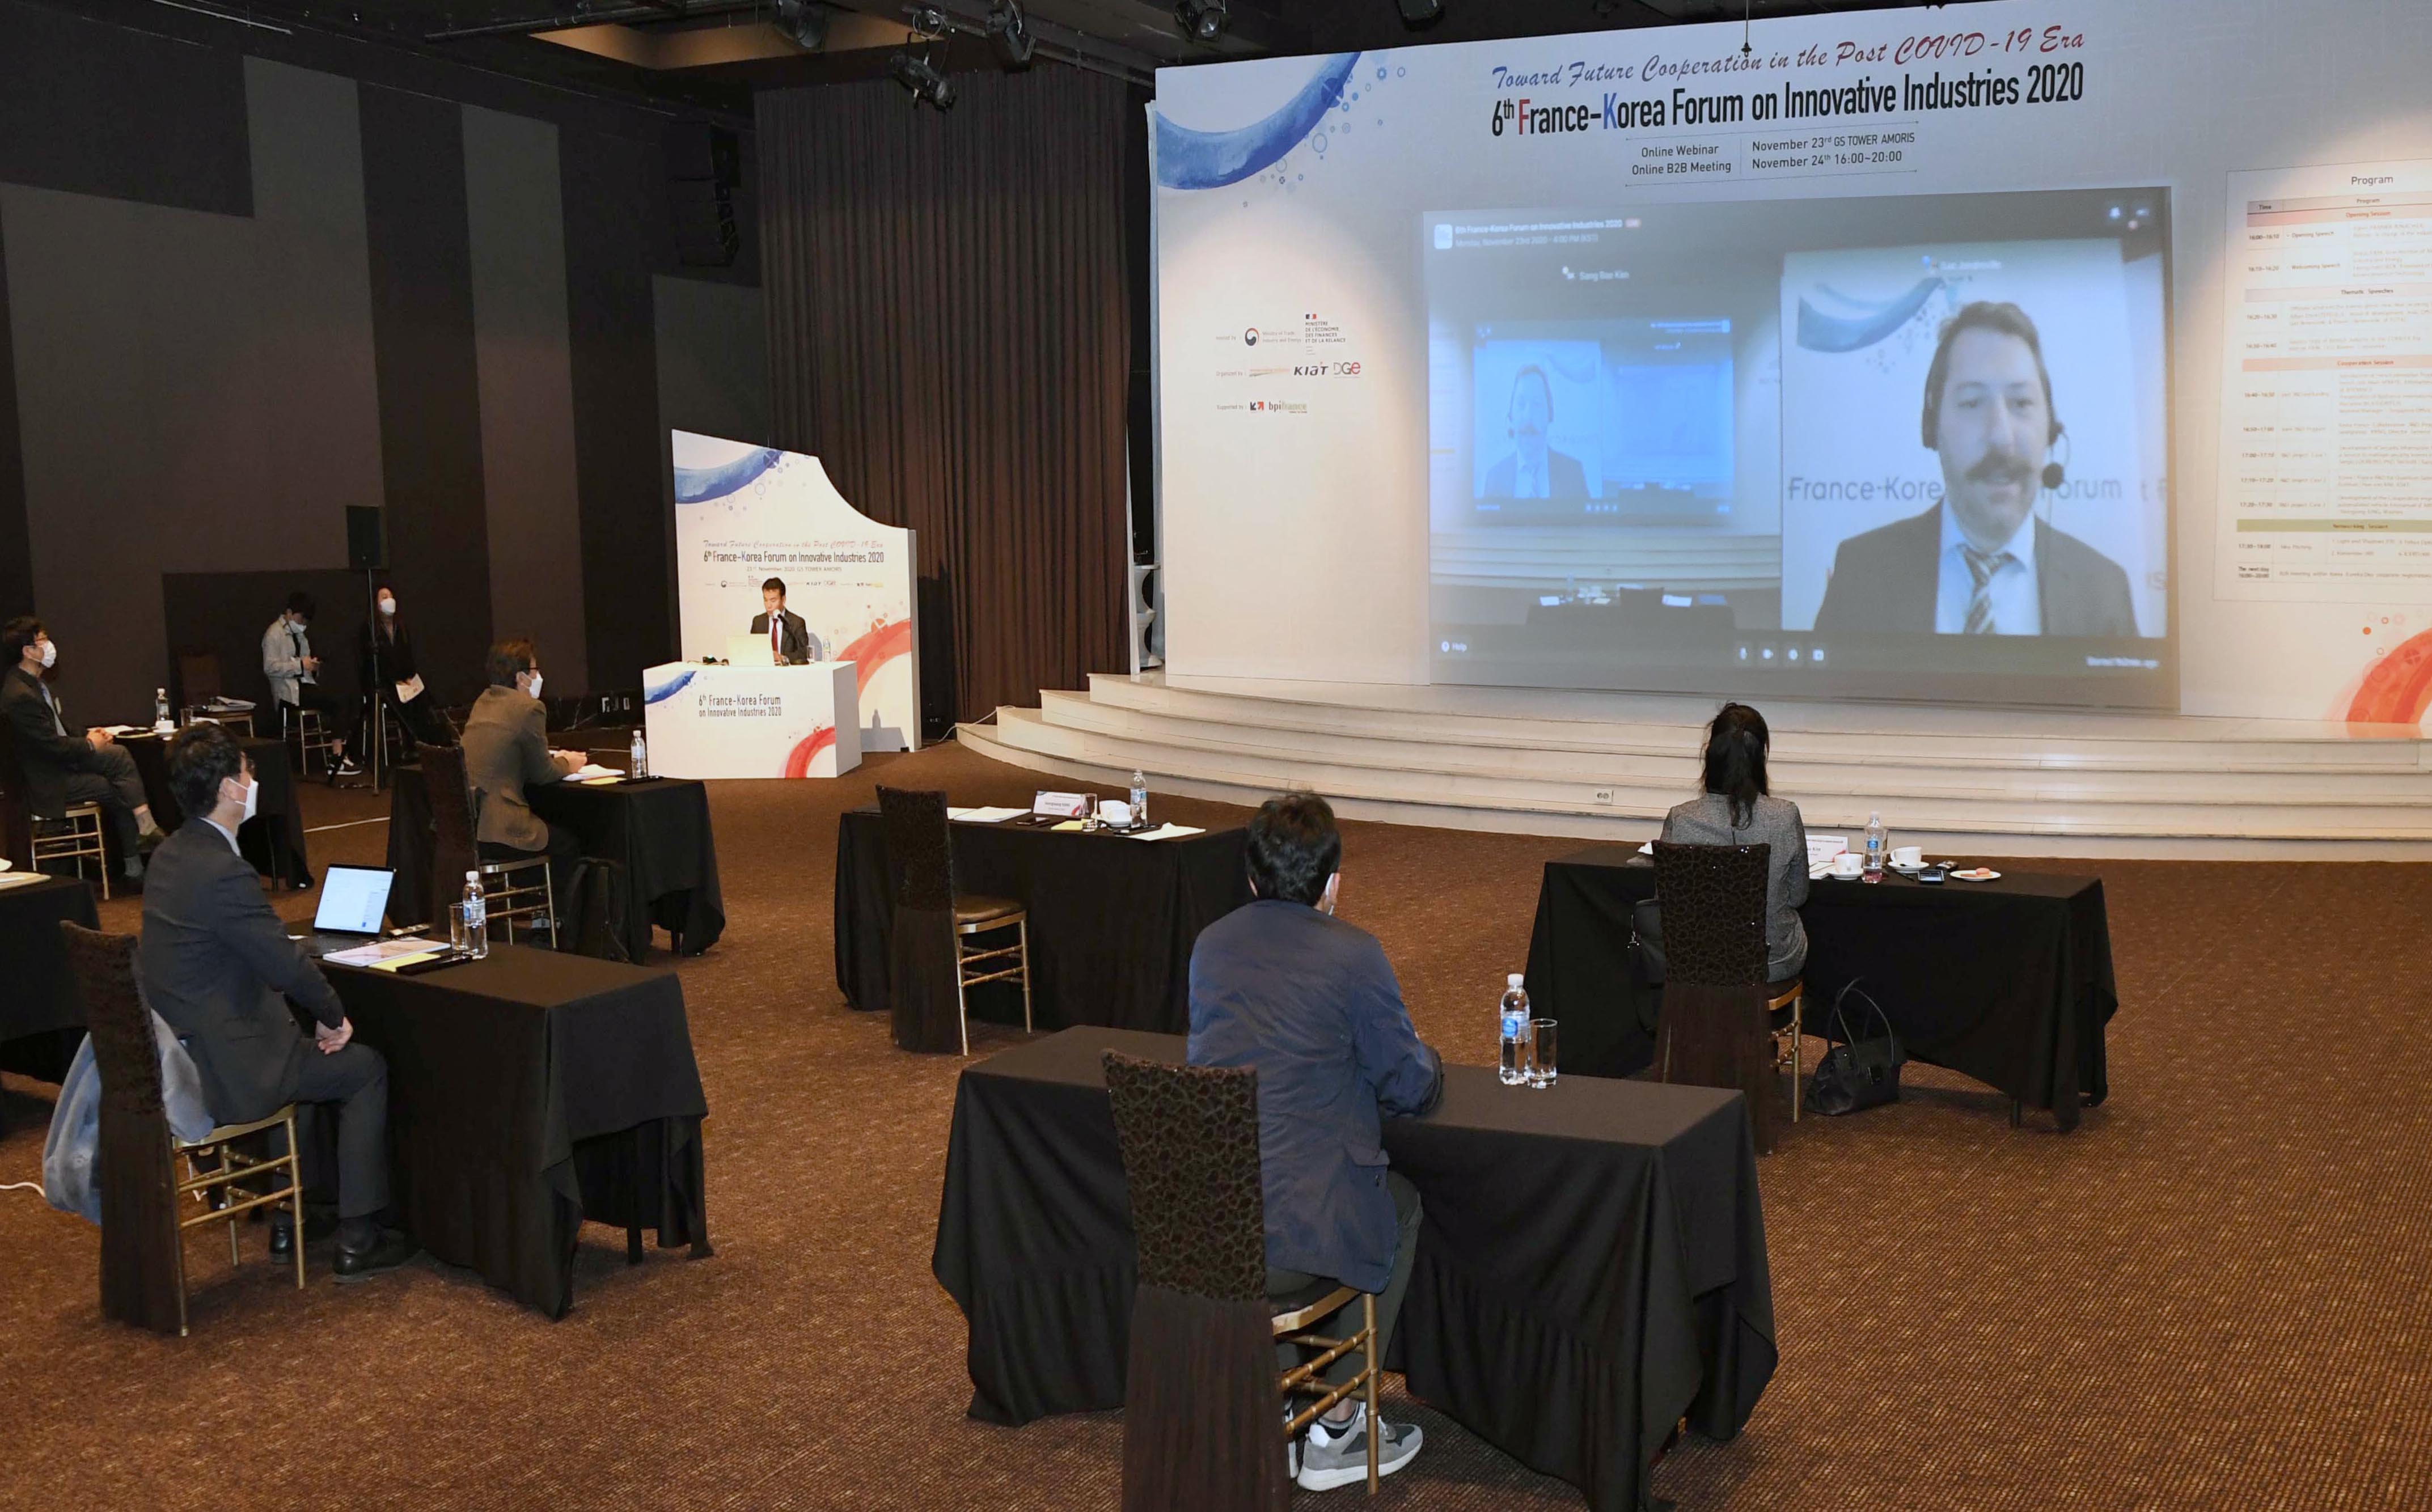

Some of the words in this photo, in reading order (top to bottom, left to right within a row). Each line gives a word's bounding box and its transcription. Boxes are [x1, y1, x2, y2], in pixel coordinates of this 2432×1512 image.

[1492, 65, 1563, 88] Toward
[1568, 61, 1634, 87] Future
[1642, 55, 1762, 82] Cooperation
[1770, 52, 1788, 69] in
[1796, 44, 1827, 66] the
[1835, 41, 1888, 66] Post
[2039, 25, 2084, 53] Era
[1492, 98, 1515, 136] 6th
[1519, 92, 1665, 135] France-Korea
[1672, 88, 1743, 125] Forum
[1752, 93, 1777, 121] on
[1785, 75, 1896, 118] Innovative
[1904, 68, 2019, 111] Industries
[2027, 62, 2084, 103] 2020
[1752, 139, 1807, 152] November
[1811, 136, 1832, 149] 23rd
[1834, 137, 1845, 147] GS
[1847, 134, 1878, 146] TOWER
[1880, 132, 1915, 145] AMORIS
[1642, 146, 1673, 158] Online
[1676, 144, 1719, 156] Webinar
[1631, 164, 1664, 175] Online
[1667, 162, 1687, 173] B2B
[1690, 161, 1731, 173] Meeting
[1752, 157, 1807, 170] November
[1811, 154, 1831, 167] 24th
[2351, 176, 2393, 187] Program
[1788, 476, 1943, 500] France-Kore
[713, 550, 762, 562] France-Korea
[764, 551, 786, 562] Forum
[789, 554, 797, 562] on
[798, 550, 832, 562] Innovative
[834, 551, 866, 562] Industries
[868, 552, 884, 562] 2020
[709, 694, 756, 706] France-Korea
[759, 693, 781, 705] Forum
[708, 708, 736, 717] Innovative
[738, 708, 766, 717] Industries
[768, 706, 781, 717] 2020
